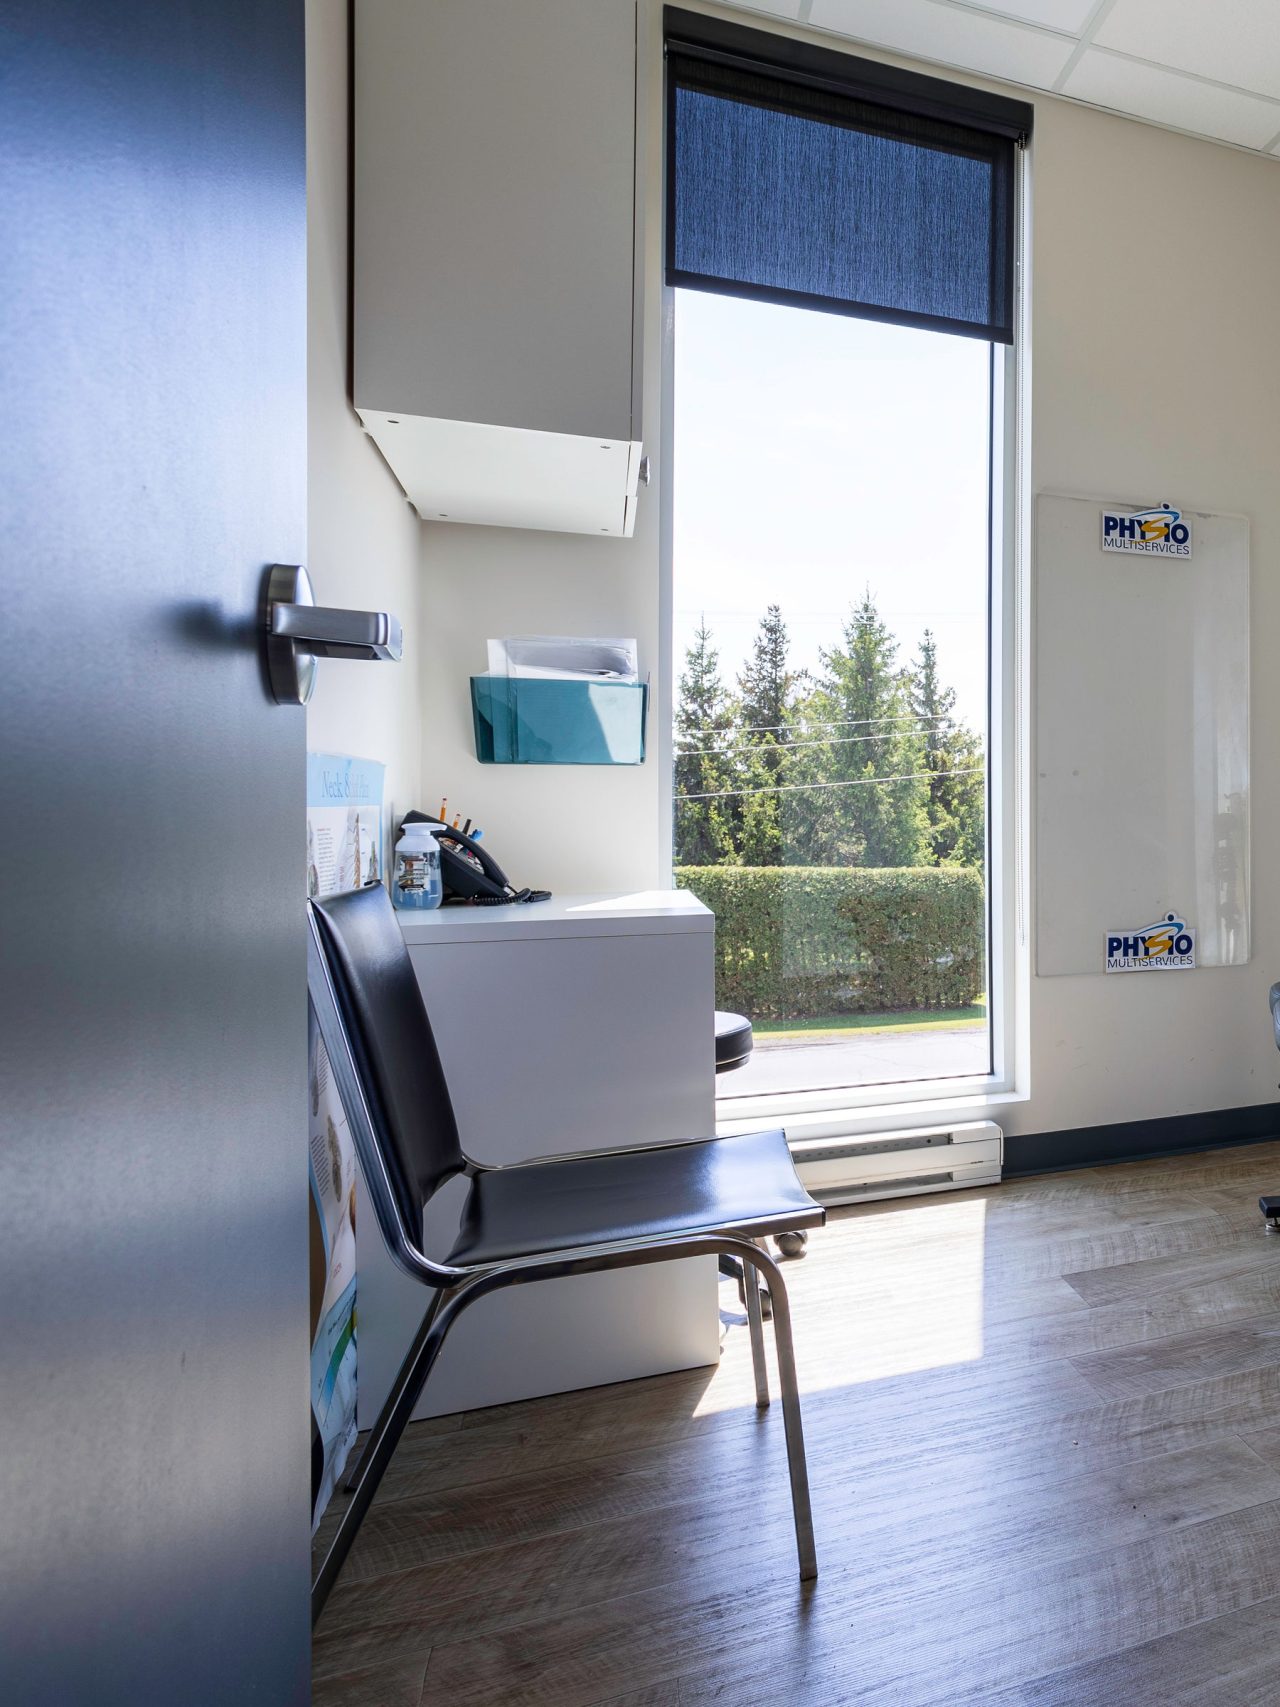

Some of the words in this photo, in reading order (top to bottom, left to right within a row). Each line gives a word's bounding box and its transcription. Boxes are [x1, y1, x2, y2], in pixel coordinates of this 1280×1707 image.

[1104, 515, 1189, 544] PHYSIO
[1104, 537, 1190, 555] MULTISERVICES
[321, 770, 343, 798] Neck
[1108, 931, 1192, 958] PHYSIO
[1108, 956, 1192, 968] MULTISERVICES
